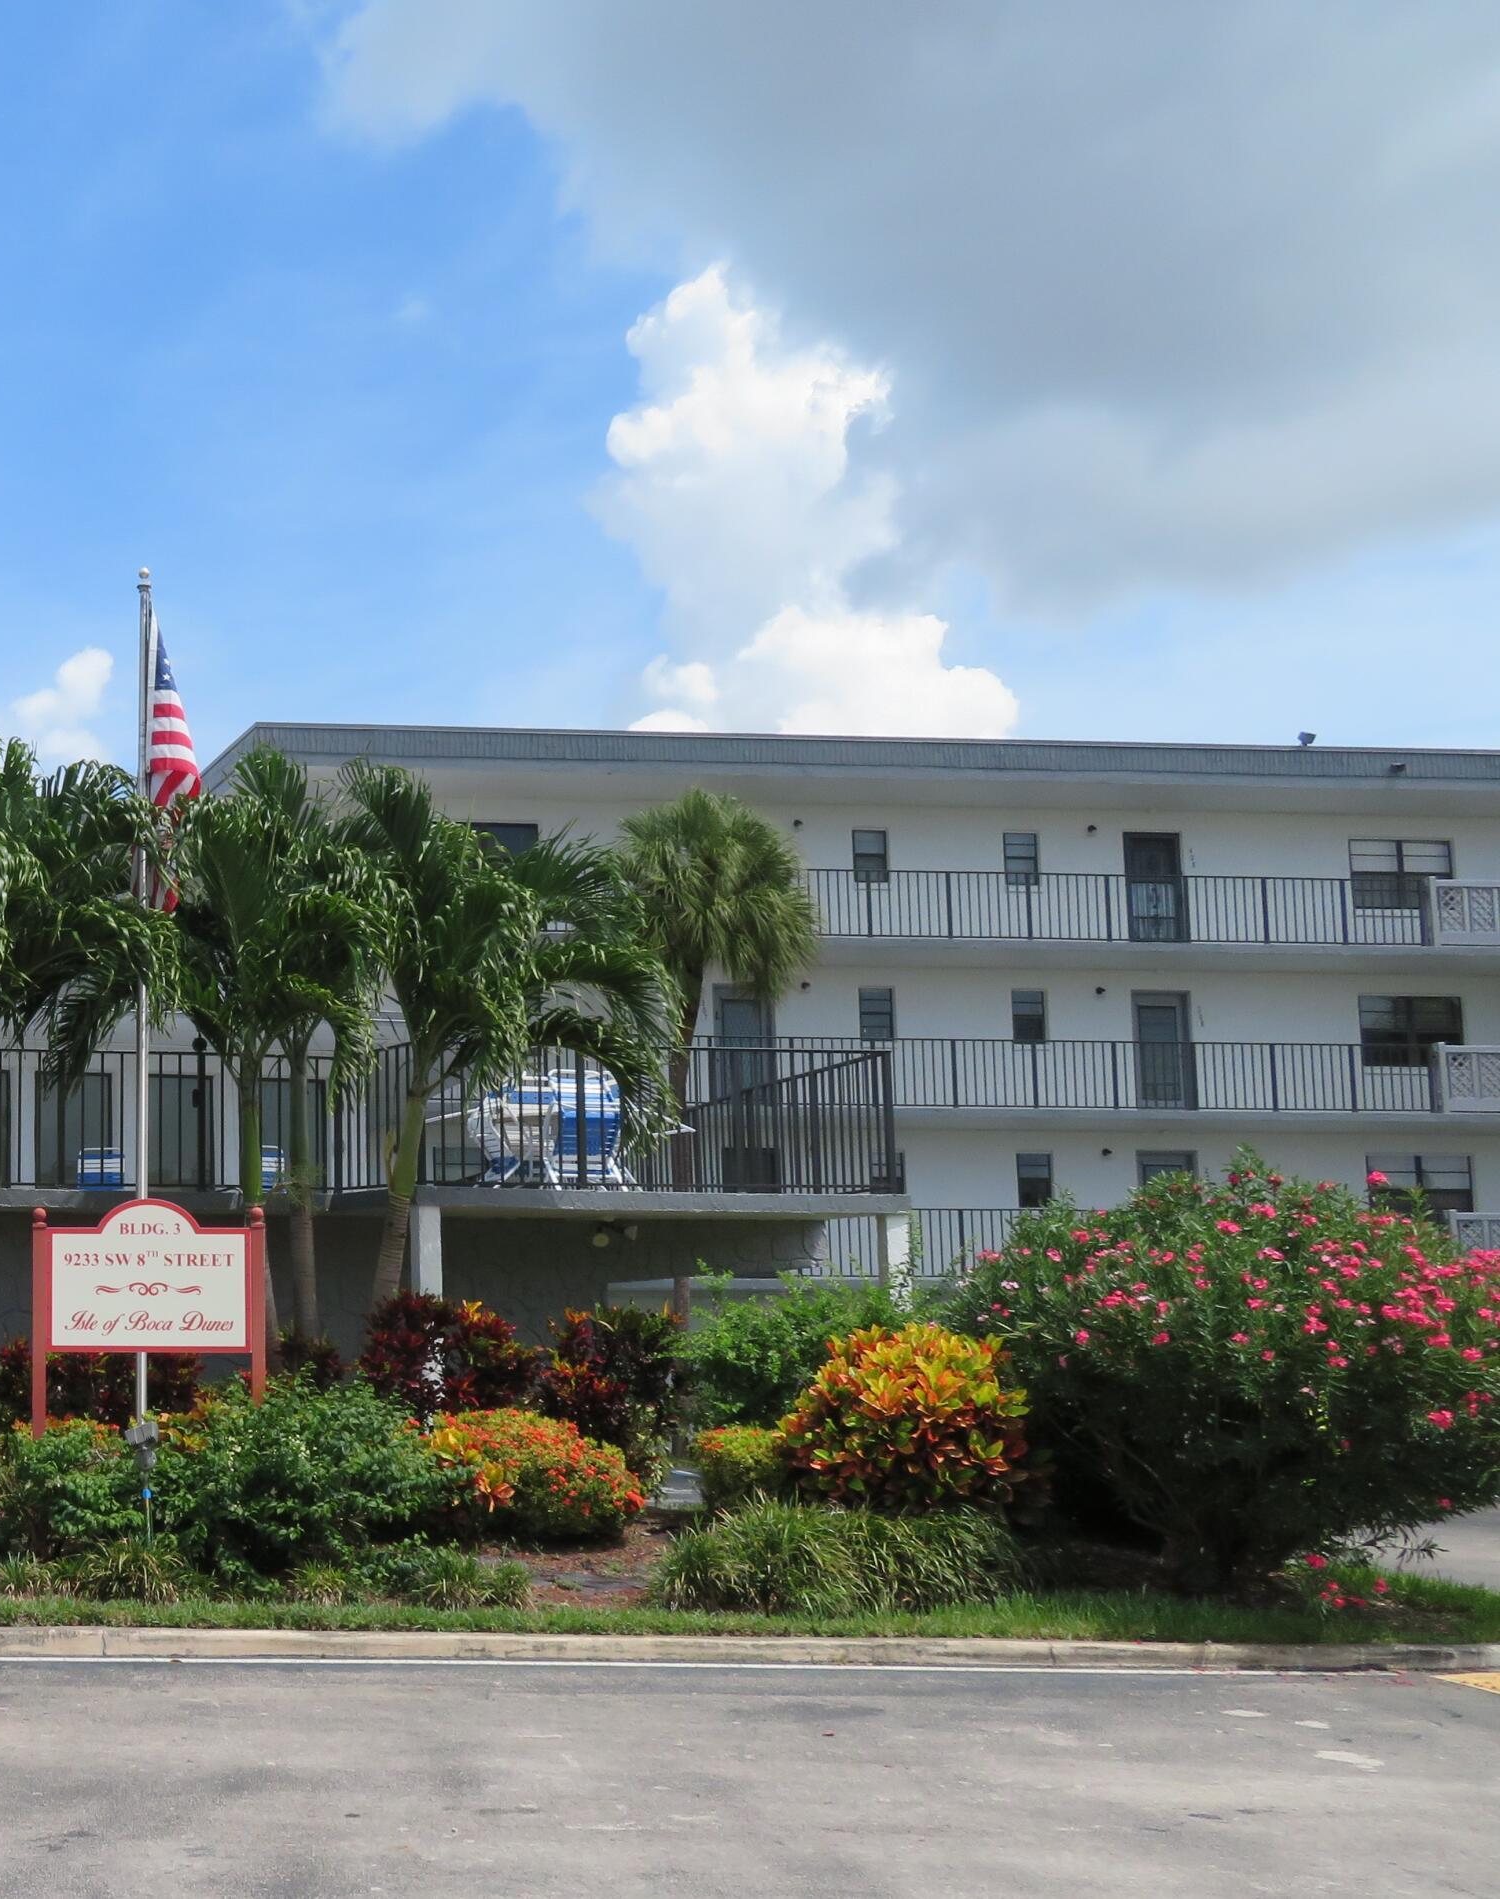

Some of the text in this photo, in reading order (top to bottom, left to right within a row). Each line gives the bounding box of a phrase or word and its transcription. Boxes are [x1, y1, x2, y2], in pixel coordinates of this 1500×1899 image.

[119, 1223, 181, 1236] BLDG. 3
[64, 1250, 235, 1267] 9233 SW 8TH STREET
[64, 1310, 234, 1336] Isle of Boca Dunes
